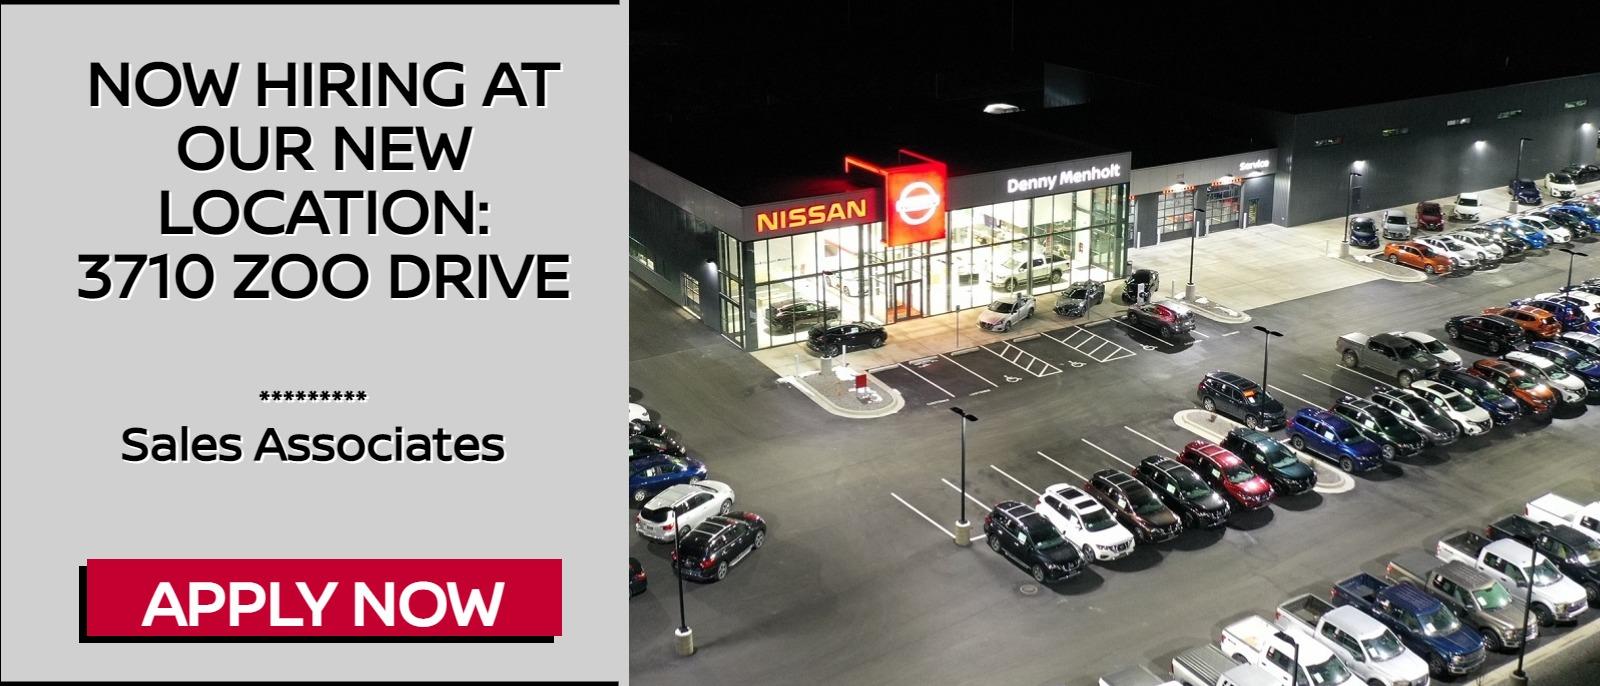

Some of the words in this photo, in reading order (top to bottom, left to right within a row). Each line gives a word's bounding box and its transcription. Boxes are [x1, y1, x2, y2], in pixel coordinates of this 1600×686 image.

[1007, 175, 1057, 193] Denny
[1059, 163, 1120, 185] Menholt
[1239, 159, 1270, 171] Service
[756, 199, 866, 232] NISSAN
